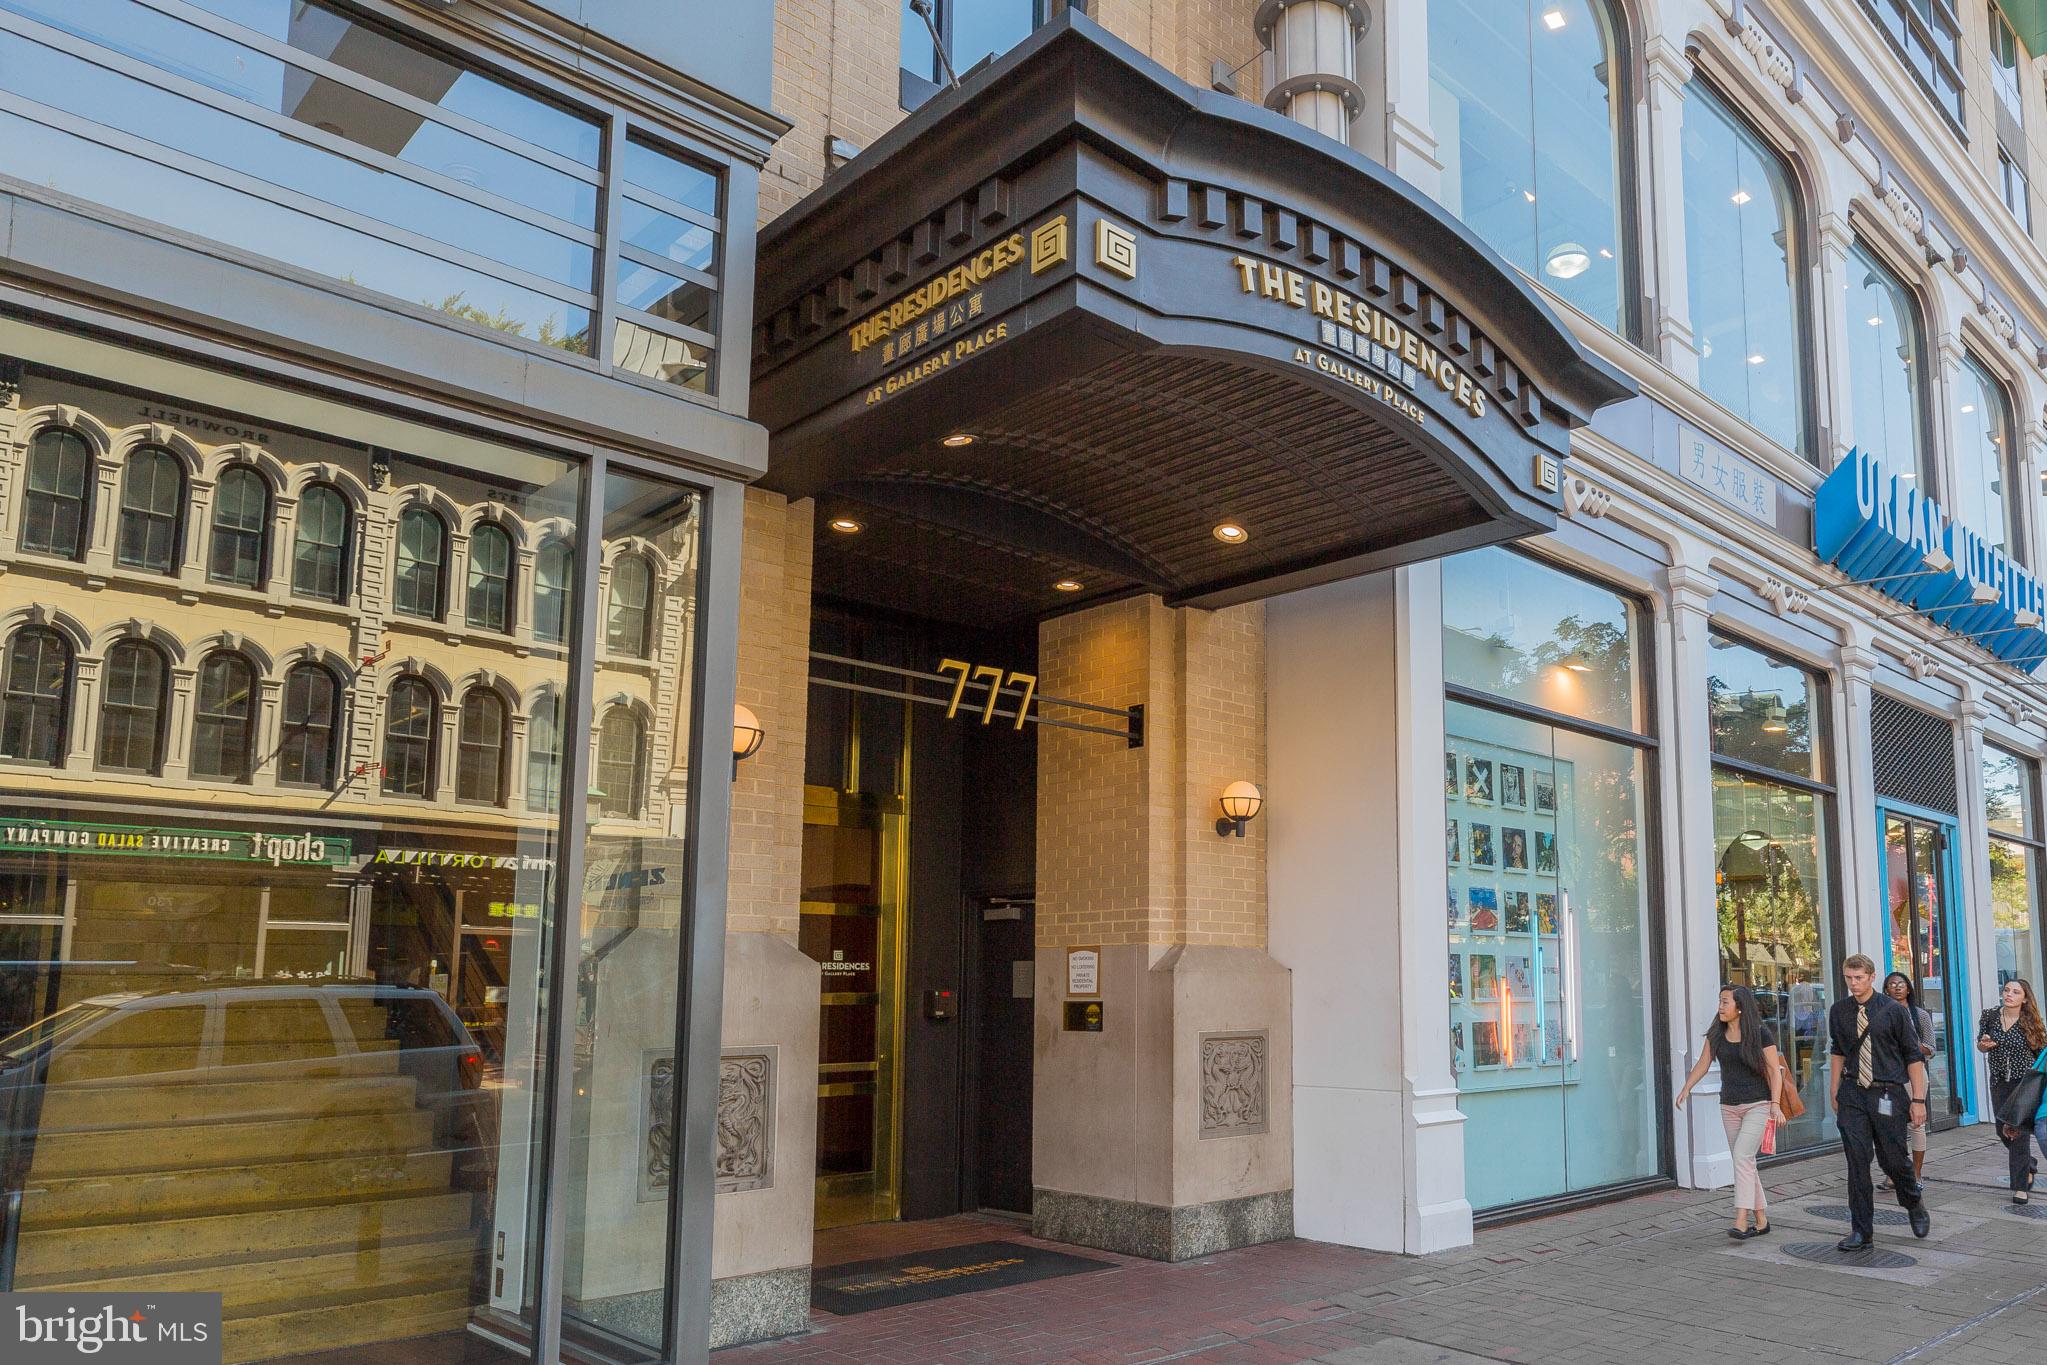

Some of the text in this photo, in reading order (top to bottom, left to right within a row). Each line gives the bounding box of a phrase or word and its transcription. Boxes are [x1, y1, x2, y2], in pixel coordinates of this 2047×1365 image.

[849, 233, 1025, 352] THE RESIDENCES
[866, 322, 1008, 405] AT GALLERY PLACE
[1233, 255, 1487, 418] THE RESIDENCES
[1294, 347, 1425, 424] AT GALLERY PLACE
[1855, 445, 1944, 556] URBAN
[938, 658, 1037, 731] 777
[821, 962, 870, 970] RESIDENCES
